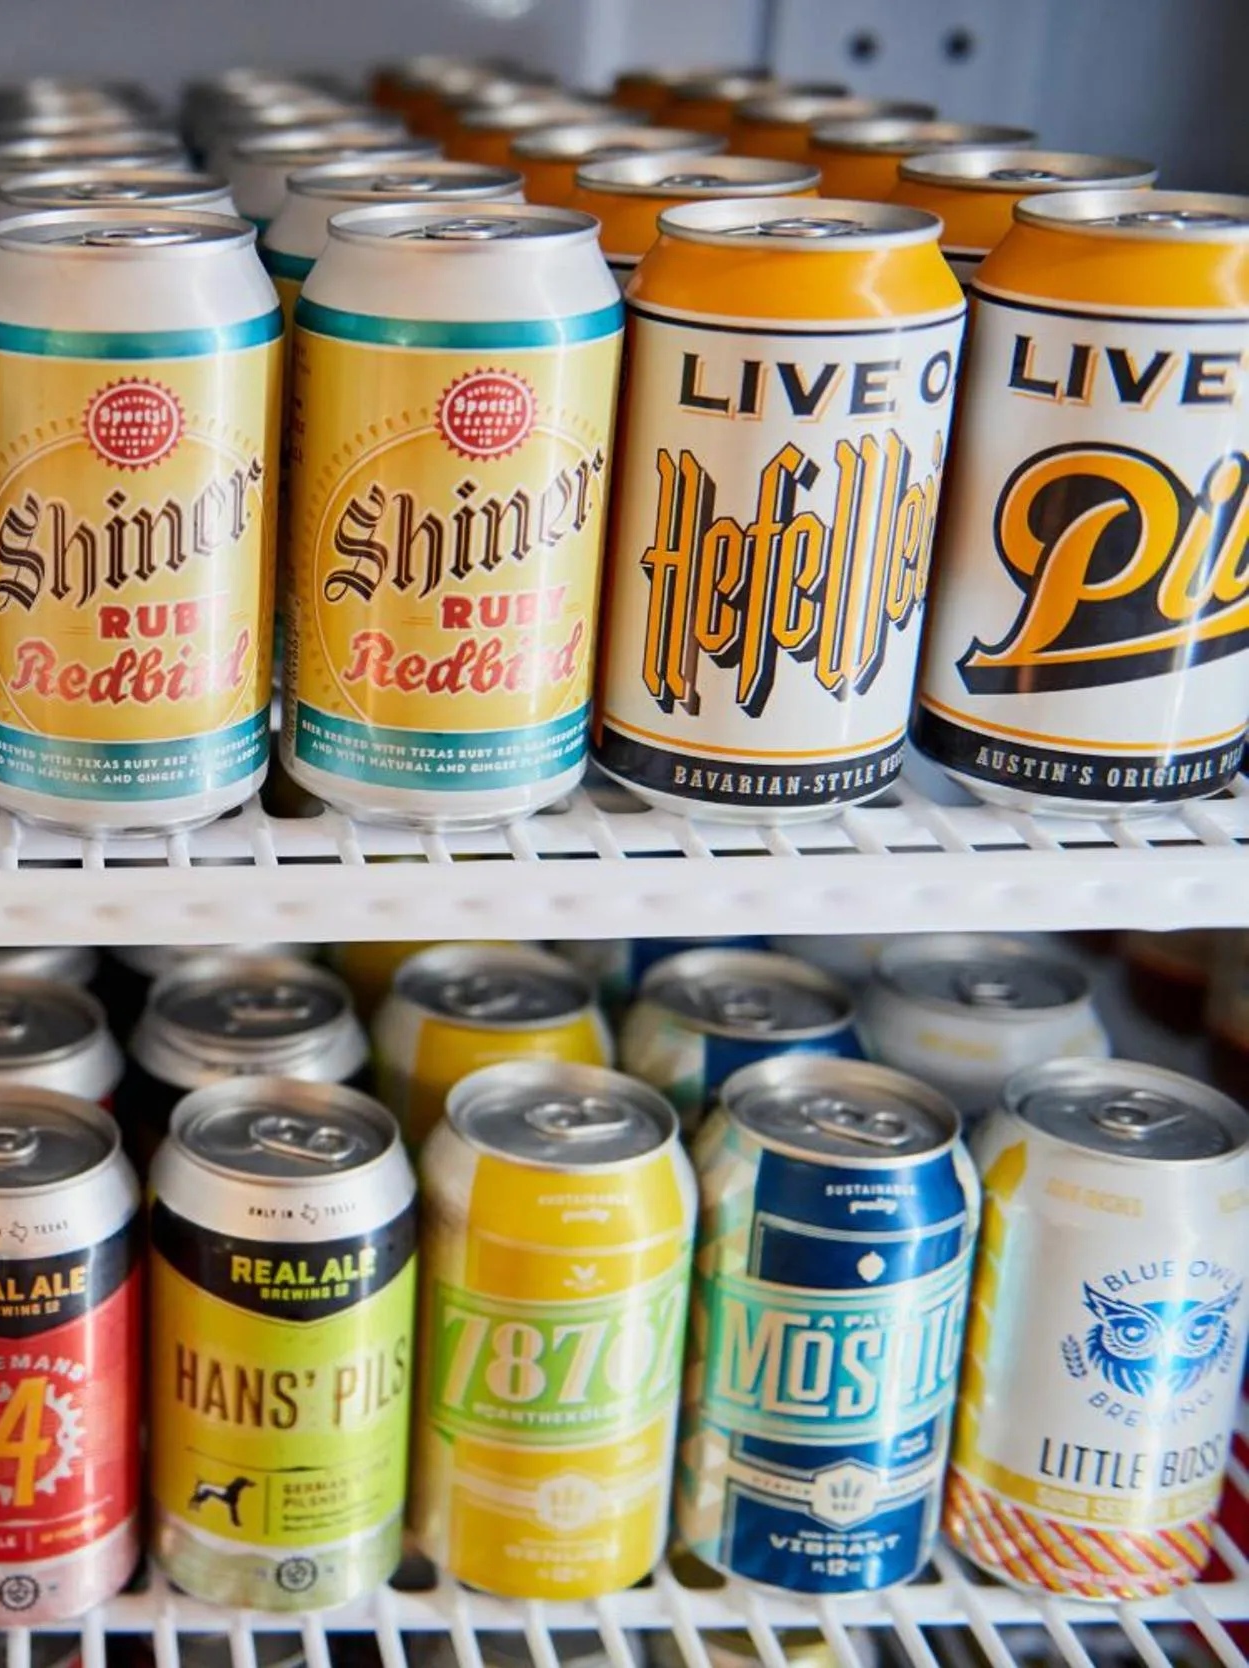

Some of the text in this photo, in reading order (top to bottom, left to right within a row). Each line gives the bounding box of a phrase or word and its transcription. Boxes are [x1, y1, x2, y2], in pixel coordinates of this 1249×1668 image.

[679, 351, 900, 420] LIVE
[1008, 335, 1242, 411] LIVE
[323, 447, 605, 602] Shiner
[441, 586, 566, 630] RUBY
[75, 757, 119, 770] TEXAS
[124, 758, 159, 770] RUBY
[311, 739, 333, 755] AND
[370, 757, 432, 773] NATURAL
[435, 762, 467, 774] AND
[470, 760, 517, 774] GINGER
[410, 747, 455, 760] TEXAS
[458, 748, 493, 760] RUBY
[975, 745, 1094, 787] AUSTIN'S
[1107, 759, 1213, 789] ORIGINAL
[102, 773, 133, 785] AND
[136, 769, 185, 784] GINGER
[673, 763, 874, 796] BAVARIAN-STYLE
[248, 1206, 278, 1219] ONLY
[30, 1265, 88, 1298] ALE
[231, 1246, 378, 1285] REAL ALE
[1102, 1260, 1177, 1293] BLUE
[260, 1284, 332, 1302] BREWING
[176, 1335, 407, 1430] HANS' PILS
[1039, 1437, 1147, 1490] LITTLE
[768, 1531, 901, 1557] VIBRANT
